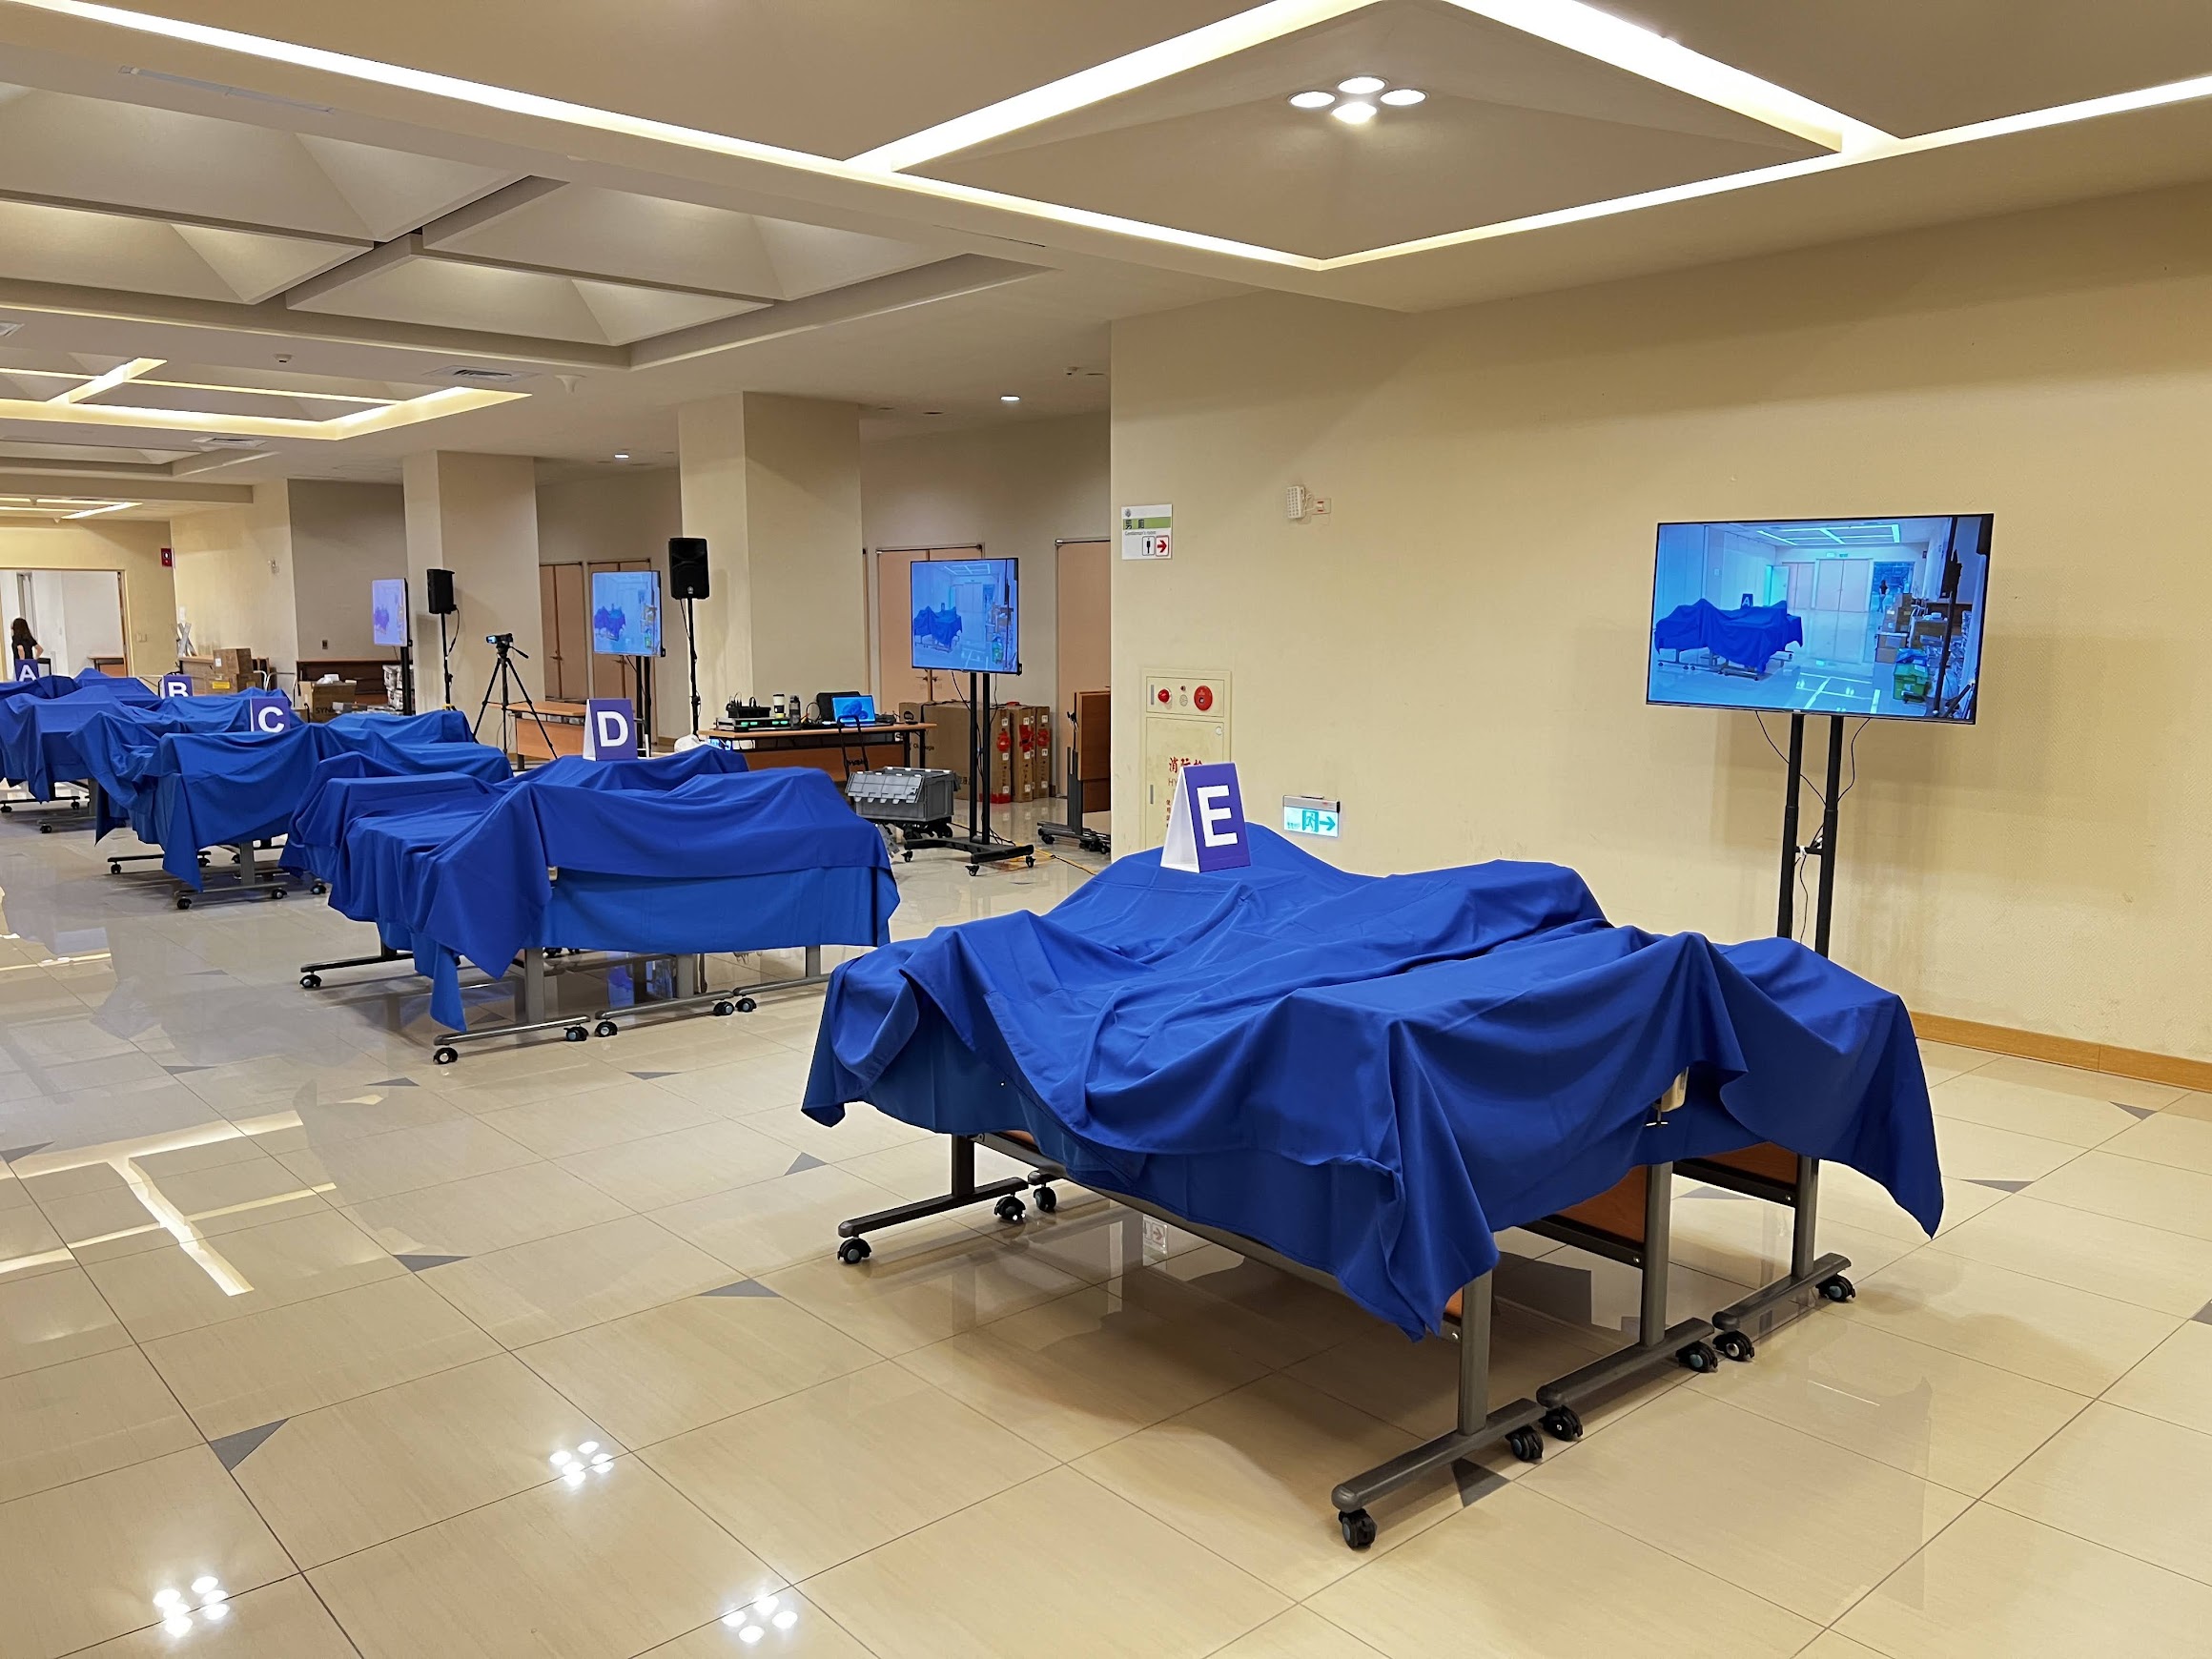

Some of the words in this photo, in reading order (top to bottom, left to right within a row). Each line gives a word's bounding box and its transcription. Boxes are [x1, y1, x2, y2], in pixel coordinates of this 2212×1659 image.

[1742, 596, 1751, 607] A
[18, 665, 37, 682] A
[168, 682, 189, 697] B
[258, 707, 285, 733] C
[597, 711, 629, 748] D
[1197, 785, 1239, 848] E
